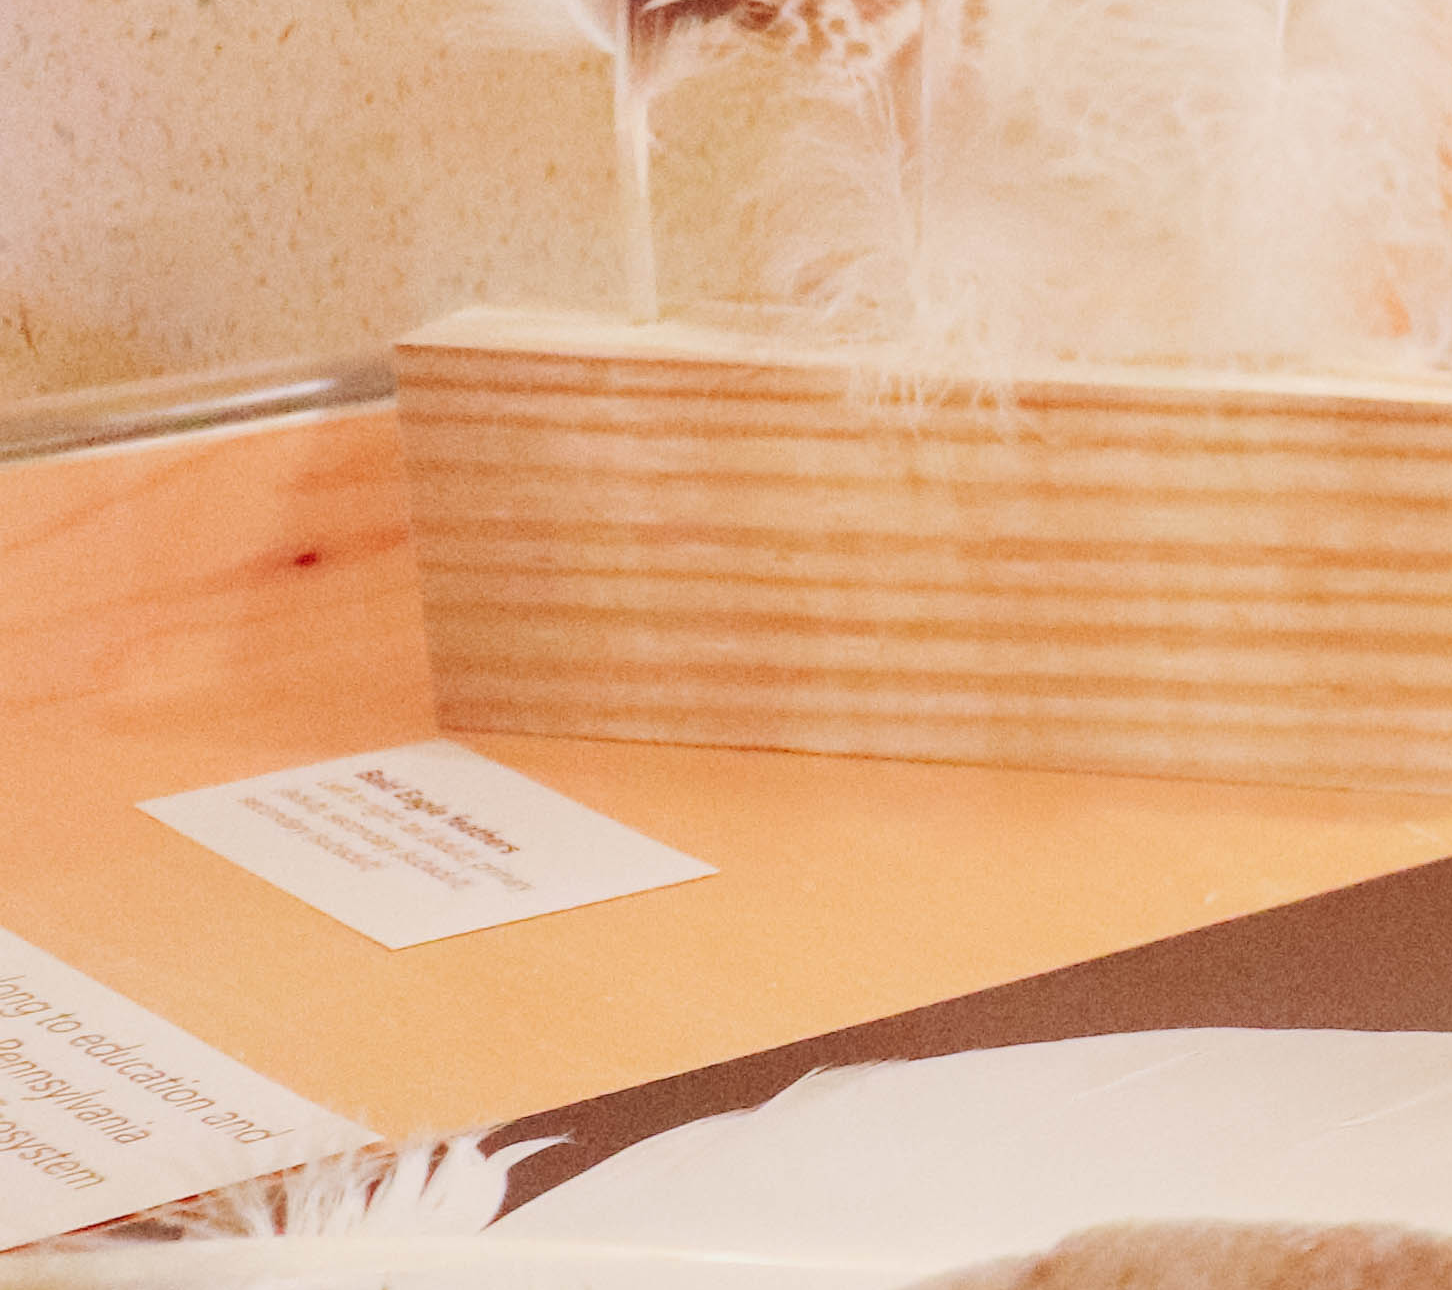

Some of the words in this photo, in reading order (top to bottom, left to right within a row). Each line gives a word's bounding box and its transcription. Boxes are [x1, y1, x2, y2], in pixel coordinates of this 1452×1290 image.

[36, 1012, 82, 1034] to
[69, 1033, 217, 1114] education
[201, 1110, 296, 1145] and
